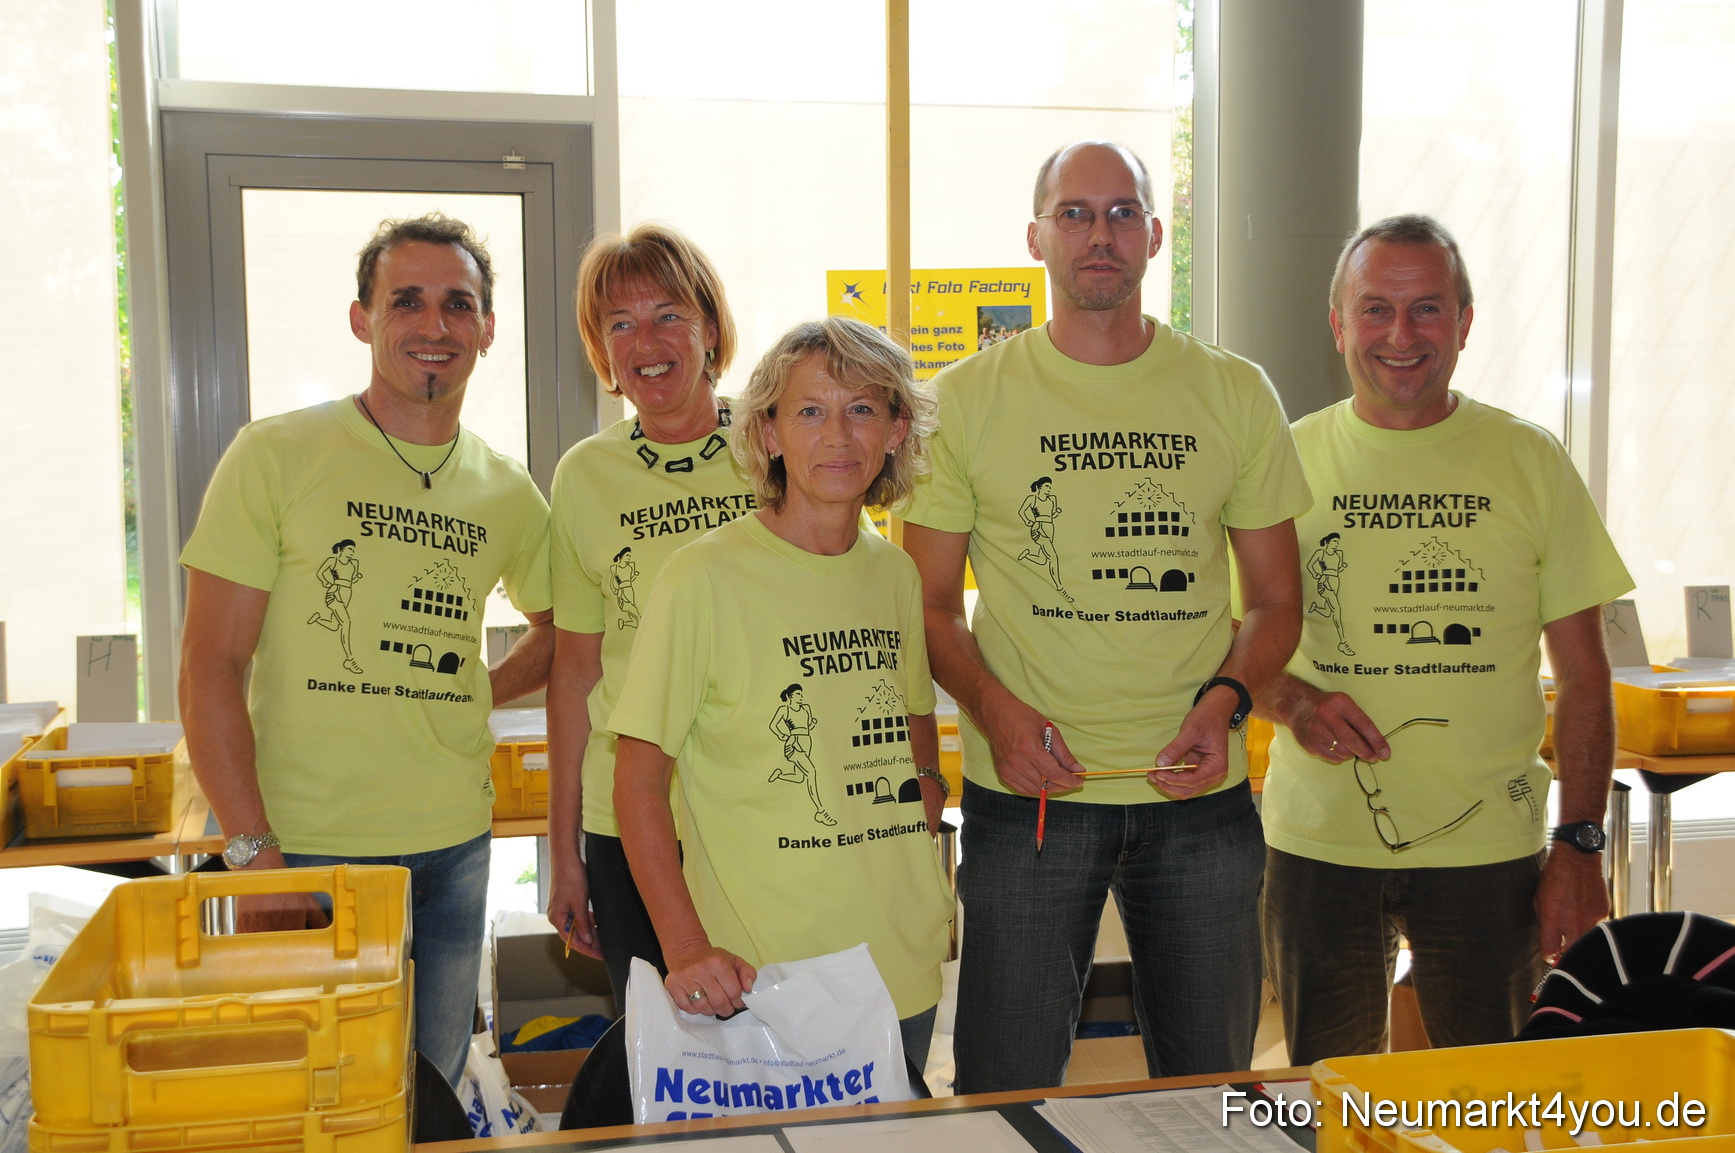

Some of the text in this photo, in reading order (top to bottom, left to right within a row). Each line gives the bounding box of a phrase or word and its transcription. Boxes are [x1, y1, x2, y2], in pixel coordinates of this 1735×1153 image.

[928, 281, 963, 294] Foto
[969, 280, 1031, 298] Factory
[933, 327, 963, 336] ganz
[938, 342, 965, 351] Foto
[1040, 432, 1198, 453] NEUMARKTER
[1054, 452, 1186, 472] STADTLAUF
[620, 494, 758, 527] NEUMARKTE
[1332, 494, 1491, 512] NEUMARKTER
[347, 501, 488, 544] NEUMARKTER
[633, 510, 747, 540] STADTLA
[1344, 512, 1477, 529] STADTLAUF
[360, 521, 479, 557] STADTLAUF
[1032, 604, 1208, 622] Danke Euer Stadtlaufteam
[1373, 603, 1495, 613] www.stadtlauf-neumarkt.de
[782, 628, 902, 657] NEUMARKTER
[800, 650, 898, 677] STADTLAUF
[1312, 660, 1496, 676] Danke Euer Stadtlaufteam
[307, 679, 356, 694] Danke
[361, 683, 391, 696] Euer
[778, 820, 930, 849] Danke Euer Stadtlauft
[654, 1061, 875, 1110] Neumarkter
